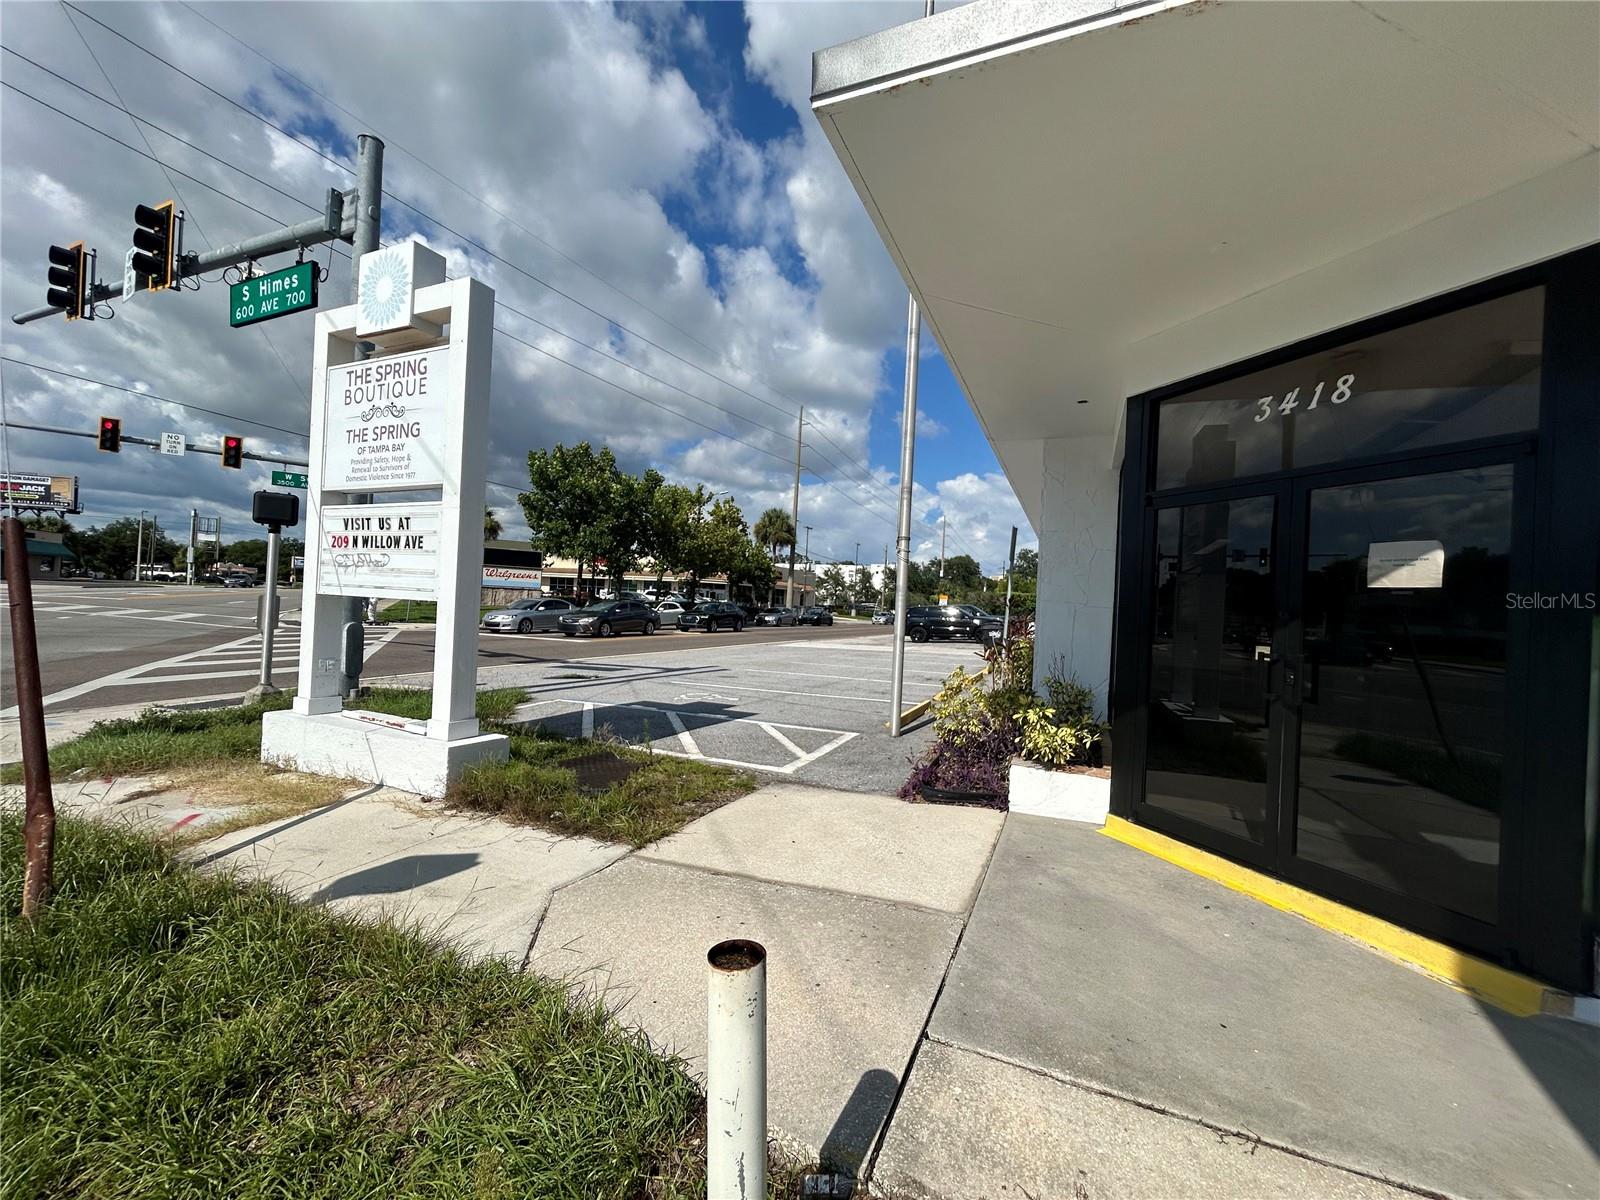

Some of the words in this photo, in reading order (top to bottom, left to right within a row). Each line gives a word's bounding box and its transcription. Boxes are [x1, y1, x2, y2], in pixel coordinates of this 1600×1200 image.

[242, 286, 250, 301] S
[259, 274, 298, 297] Himes
[235, 304, 255, 320] 600
[260, 297, 279, 314] AVE
[286, 290, 306, 306] 700
[346, 367, 372, 387] THE
[375, 357, 427, 382] SPRING
[344, 377, 427, 406] BOUTIQUE
[1254, 374, 1355, 422] 3418
[346, 427, 369, 444] THE
[372, 421, 420, 442] SPRING
[357, 446, 366, 455] OF
[368, 444, 390, 454] TAMPA
[391, 442, 406, 452] BAY
[343, 517, 372, 531] VISIT
[378, 516, 392, 530] US
[398, 516, 411, 530] AT
[331, 535, 349, 548] 209
[352, 535, 359, 548] N
[361, 535, 402, 549] WILLOW
[404, 535, 424, 549] AVE
[485, 568, 539, 581] Walgreens
